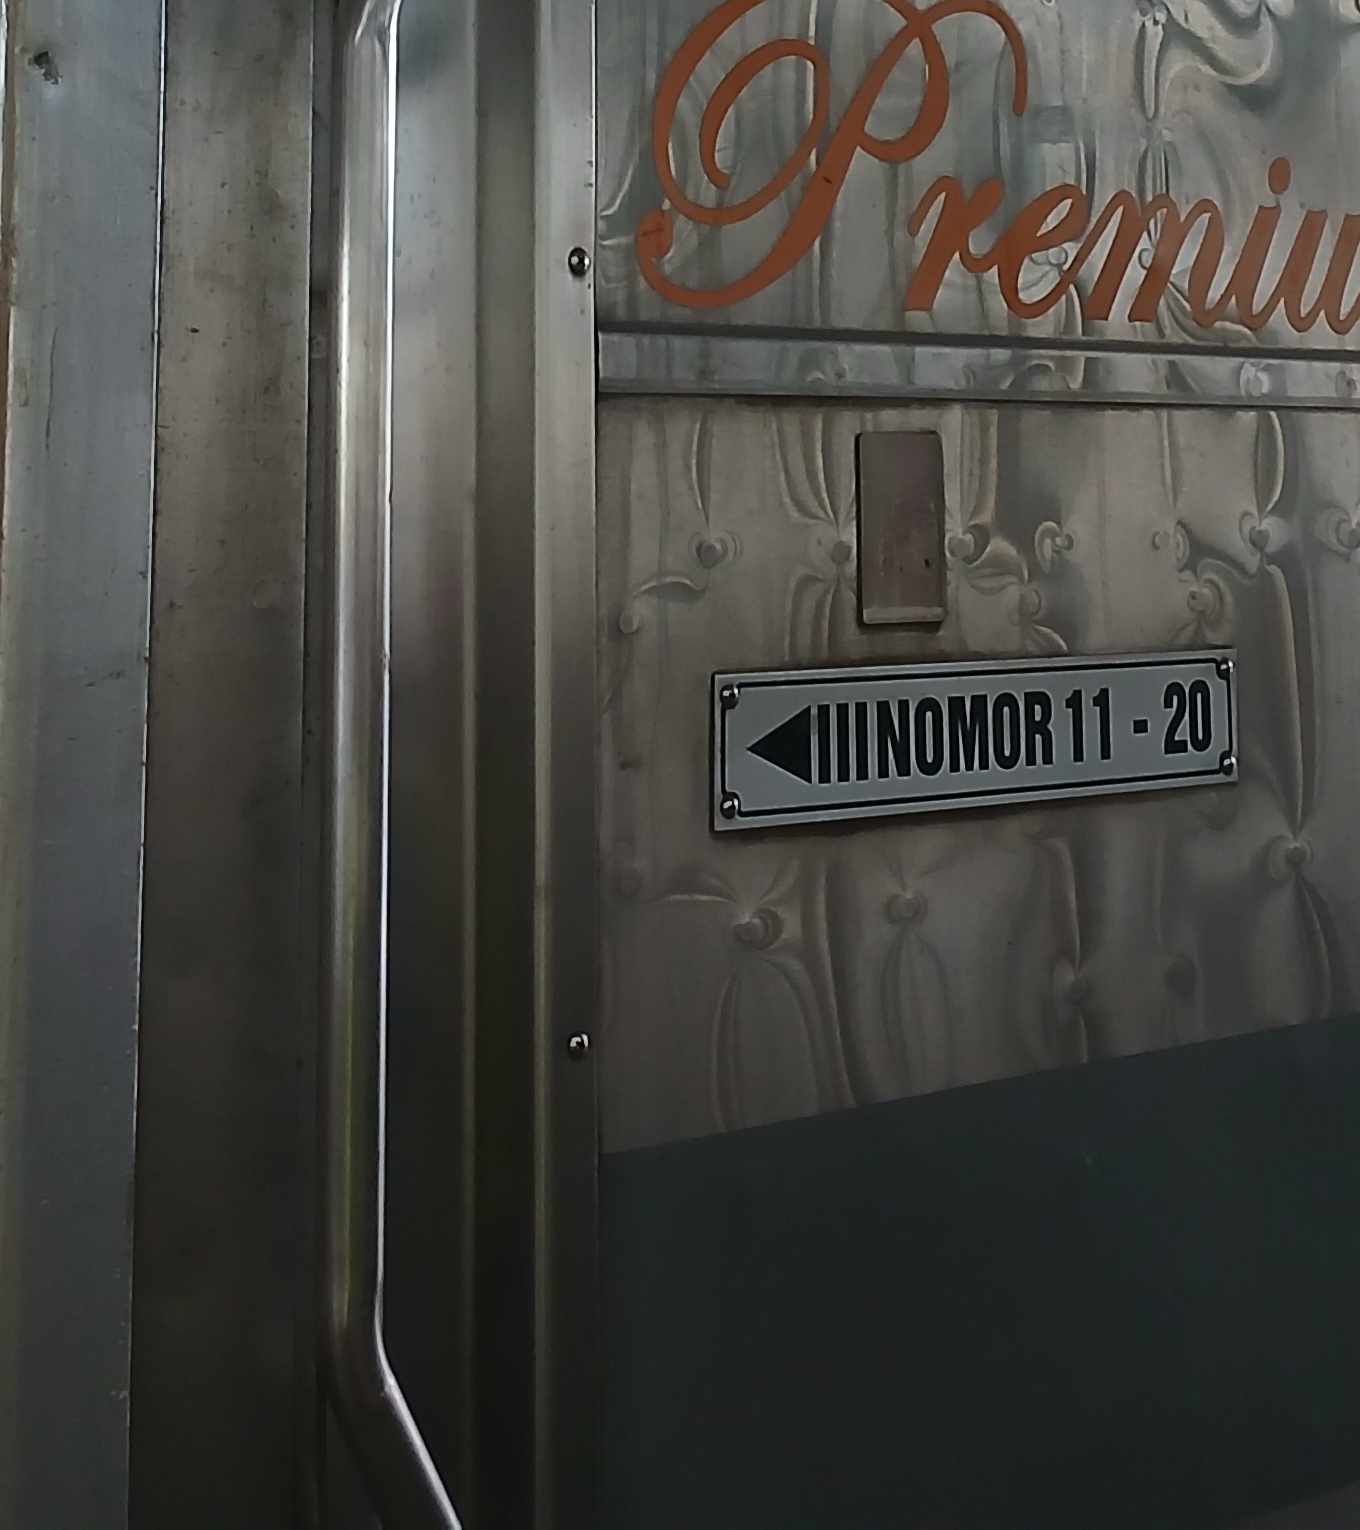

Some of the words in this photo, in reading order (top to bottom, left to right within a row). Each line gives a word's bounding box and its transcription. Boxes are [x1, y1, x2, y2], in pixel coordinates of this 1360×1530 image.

[876, 690, 1053, 779] NOMOR
[1065, 686, 1112, 763] 11
[1163, 678, 1212, 755] 20
